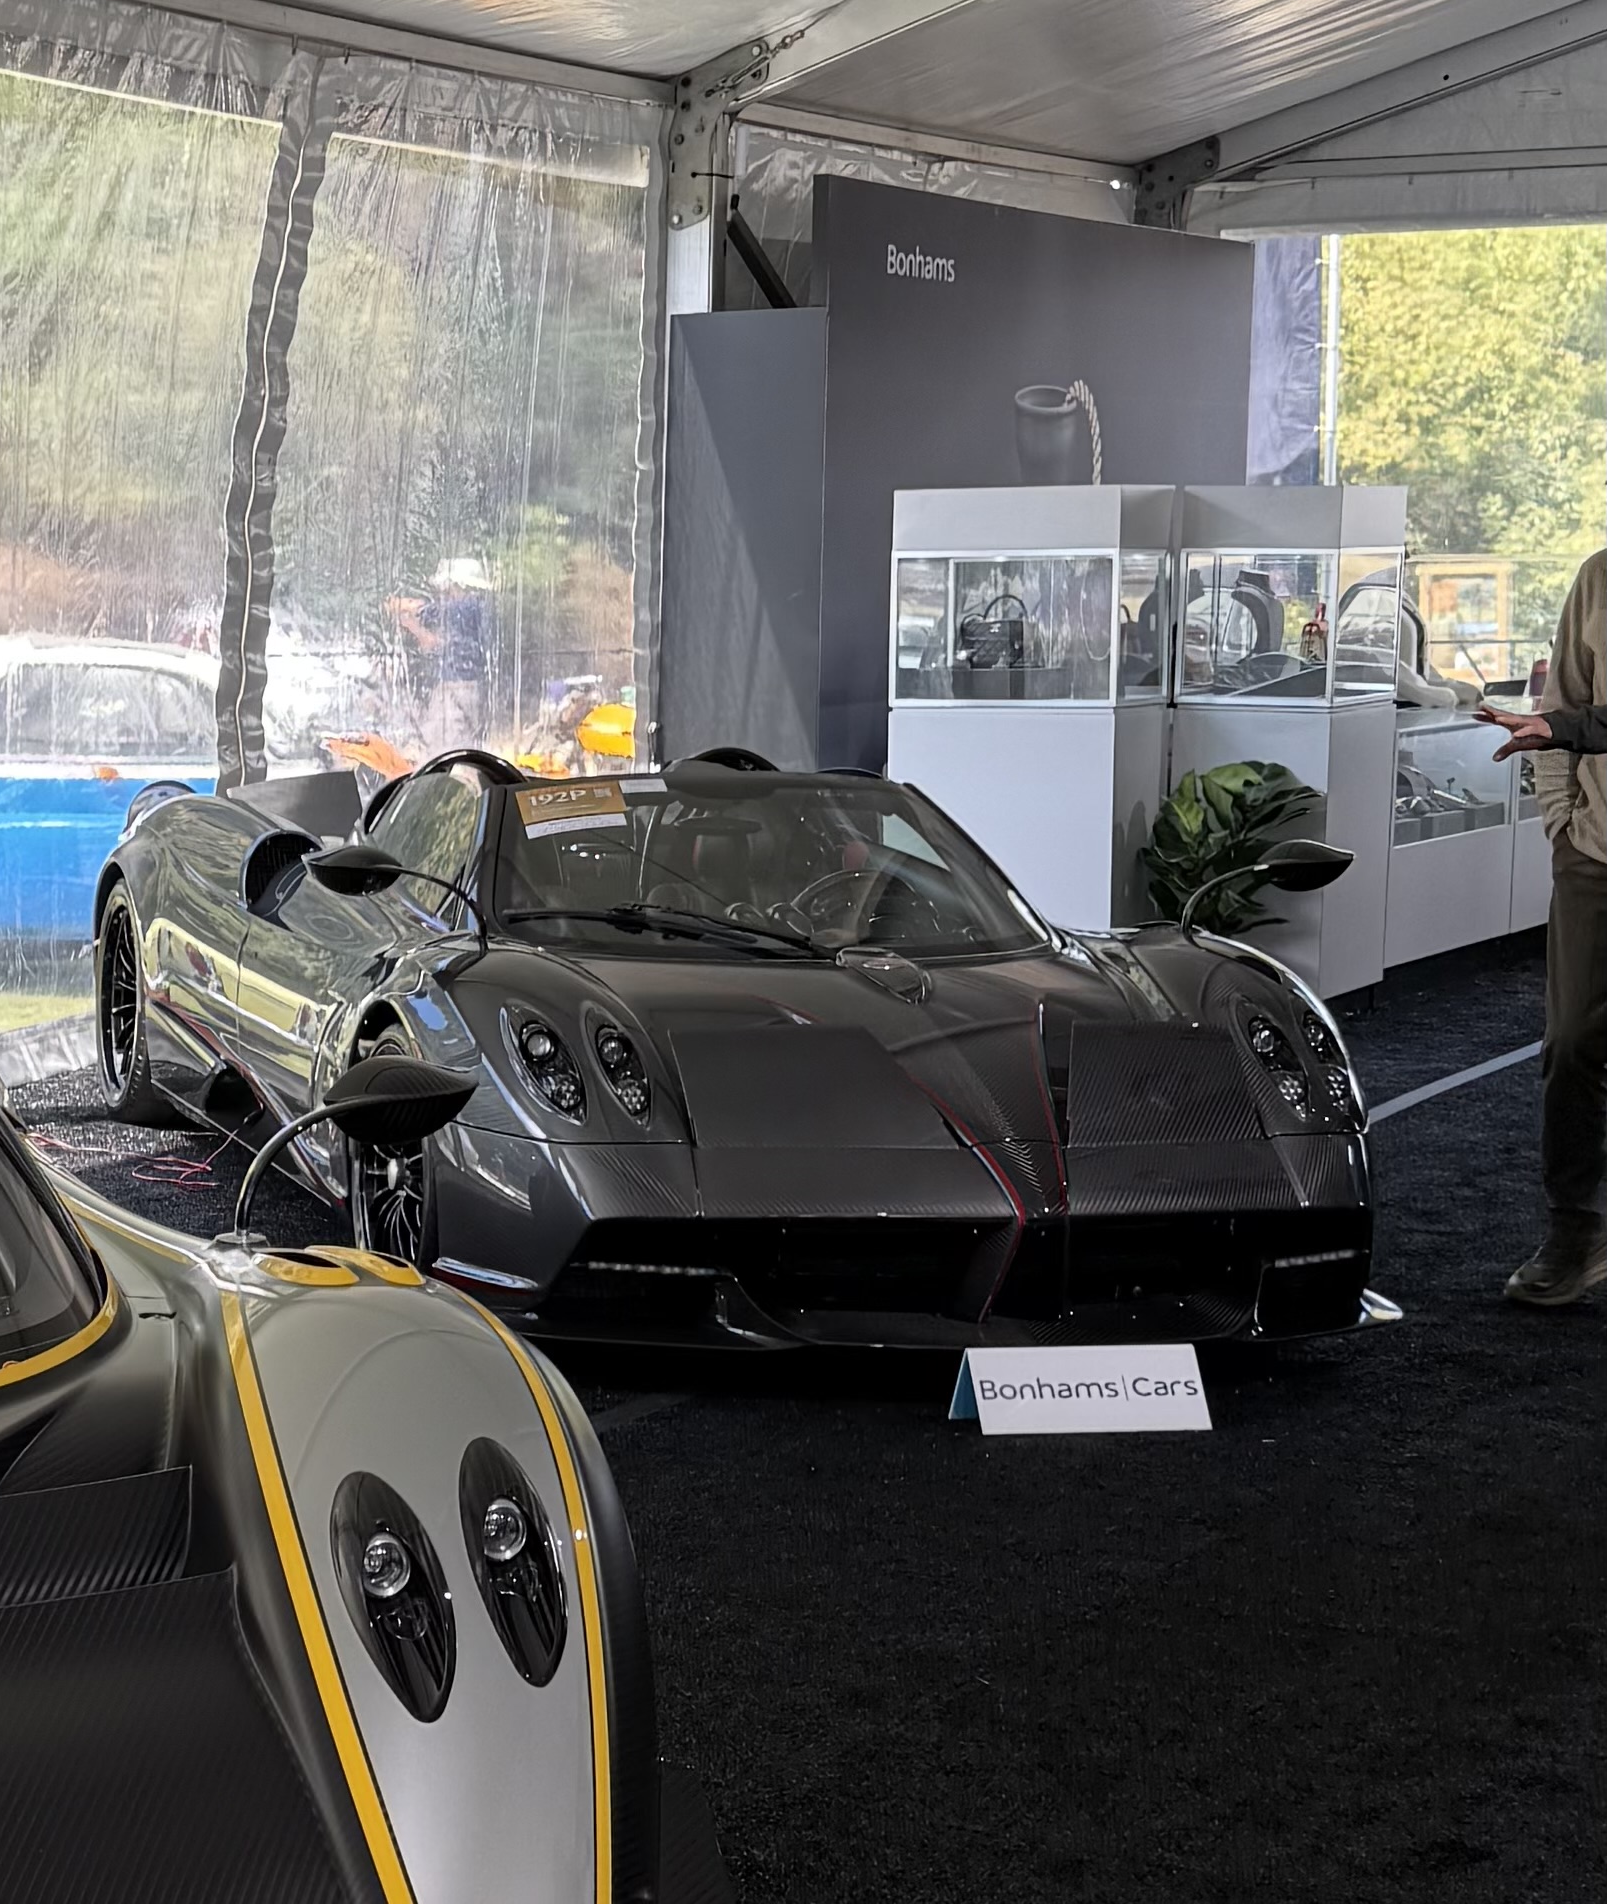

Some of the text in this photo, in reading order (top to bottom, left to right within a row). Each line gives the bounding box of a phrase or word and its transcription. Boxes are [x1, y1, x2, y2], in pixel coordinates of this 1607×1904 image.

[886, 243, 956, 283] Bonhams
[529, 789, 587, 807] 192P
[979, 1377, 1199, 1401] Bonhams Cars
